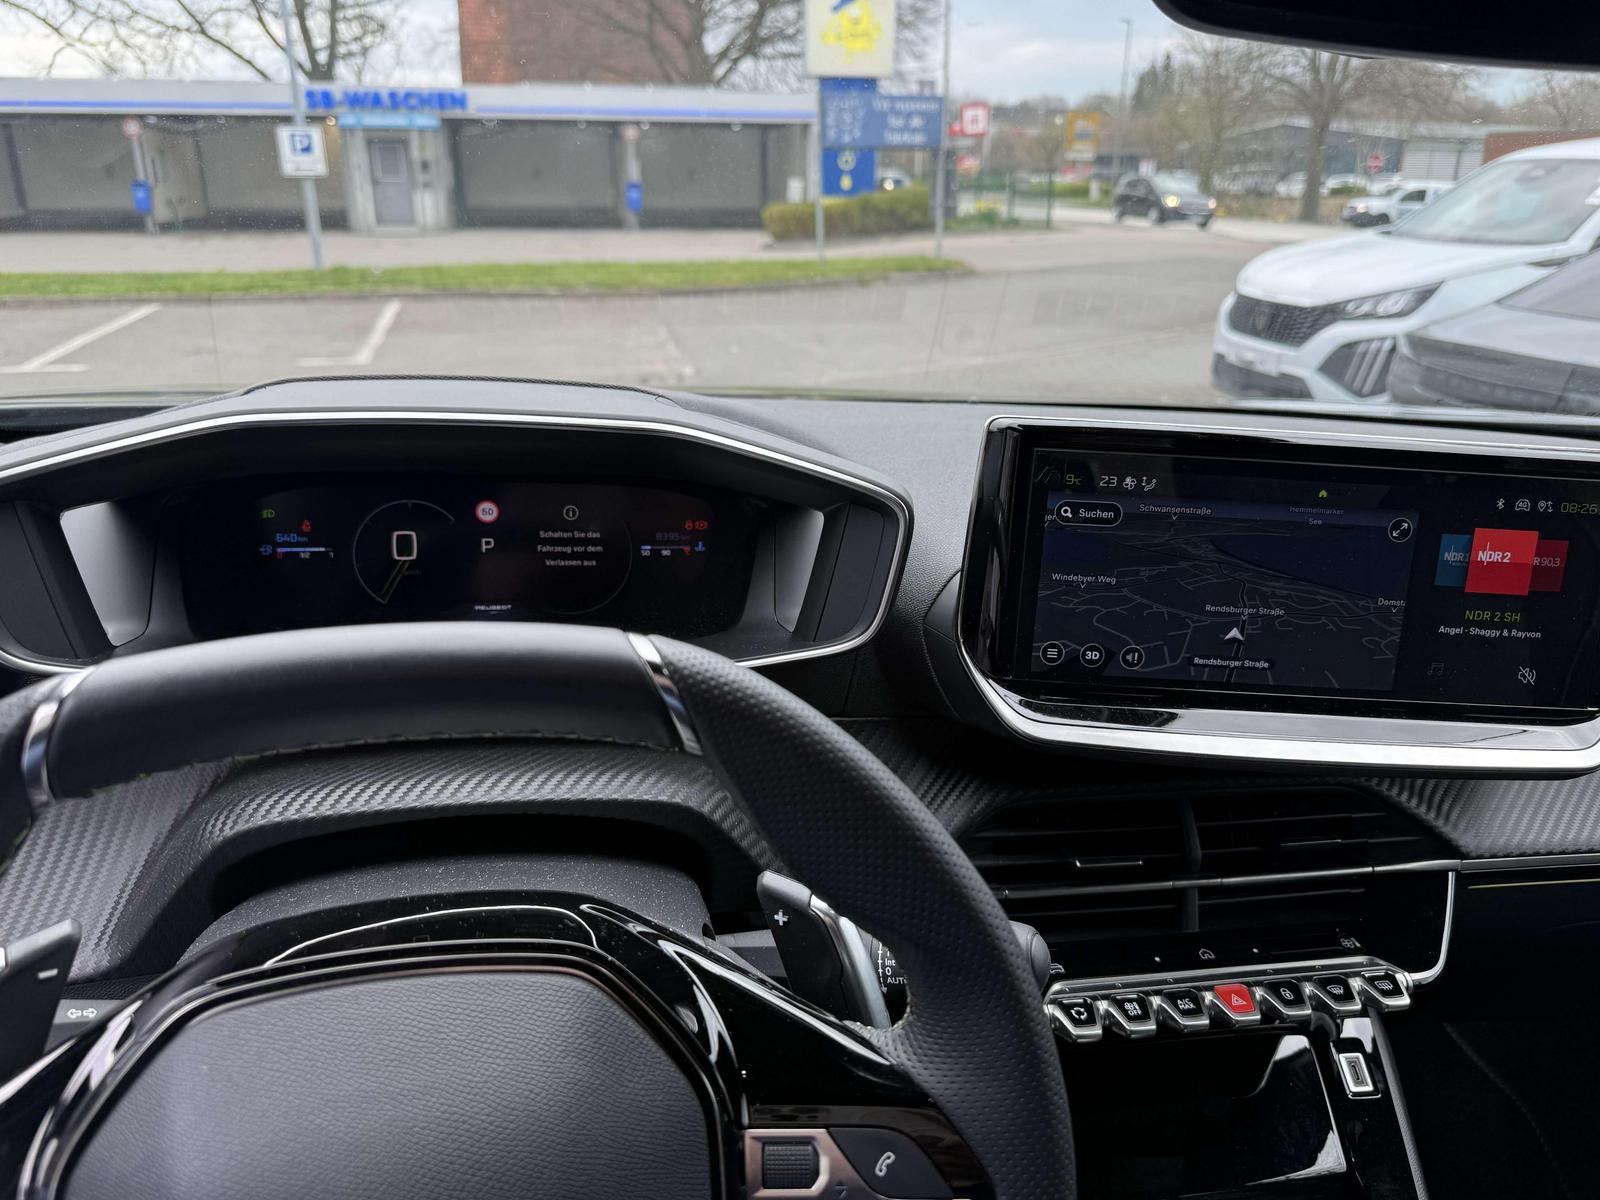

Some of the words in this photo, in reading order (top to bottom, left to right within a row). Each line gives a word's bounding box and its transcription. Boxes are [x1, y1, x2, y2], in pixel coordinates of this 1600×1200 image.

[305, 89, 468, 111] SB-WASCHEN
[1100, 475, 1118, 487] 23
[481, 507, 494, 516] 50
[1079, 508, 1115, 519] Suchen
[1139, 504, 1212, 516] Schwansenstraße
[1560, 502, 1598, 515] 08:26
[539, 530, 572, 539] Schalten
[574, 530, 586, 539] Sie
[587, 530, 601, 539] das
[391, 530, 418, 561] 0
[481, 537, 495, 553] P
[537, 544, 572, 554] Fahrzeug
[586, 544, 604, 553] dem
[641, 549, 651, 557] 50
[661, 549, 671, 557] 90
[1477, 547, 1503, 564] NDR
[1503, 552, 1511, 563] 2
[545, 558, 582, 567] Verlassen
[583, 559, 597, 567] aus
[1052, 572, 1095, 583] Windebyer
[1097, 575, 1117, 585] Weg
[1205, 604, 1256, 615] Rendsburger
[1258, 607, 1285, 616] Straße
[1464, 609, 1491, 621] NDR
[1493, 611, 1501, 622] 2
[1504, 611, 1521, 623] SH
[1438, 625, 1464, 636] Angel
[1469, 626, 1501, 638] Shaggy
[1502, 628, 1509, 637] &
[1511, 628, 1542, 639] Rayvon
[1085, 651, 1100, 660] 3D
[1193, 657, 1242, 667] Rendsburger
[1244, 659, 1270, 669] Straße
[885, 957, 896, 966] Int
[1128, 1008, 1142, 1016] OFF
